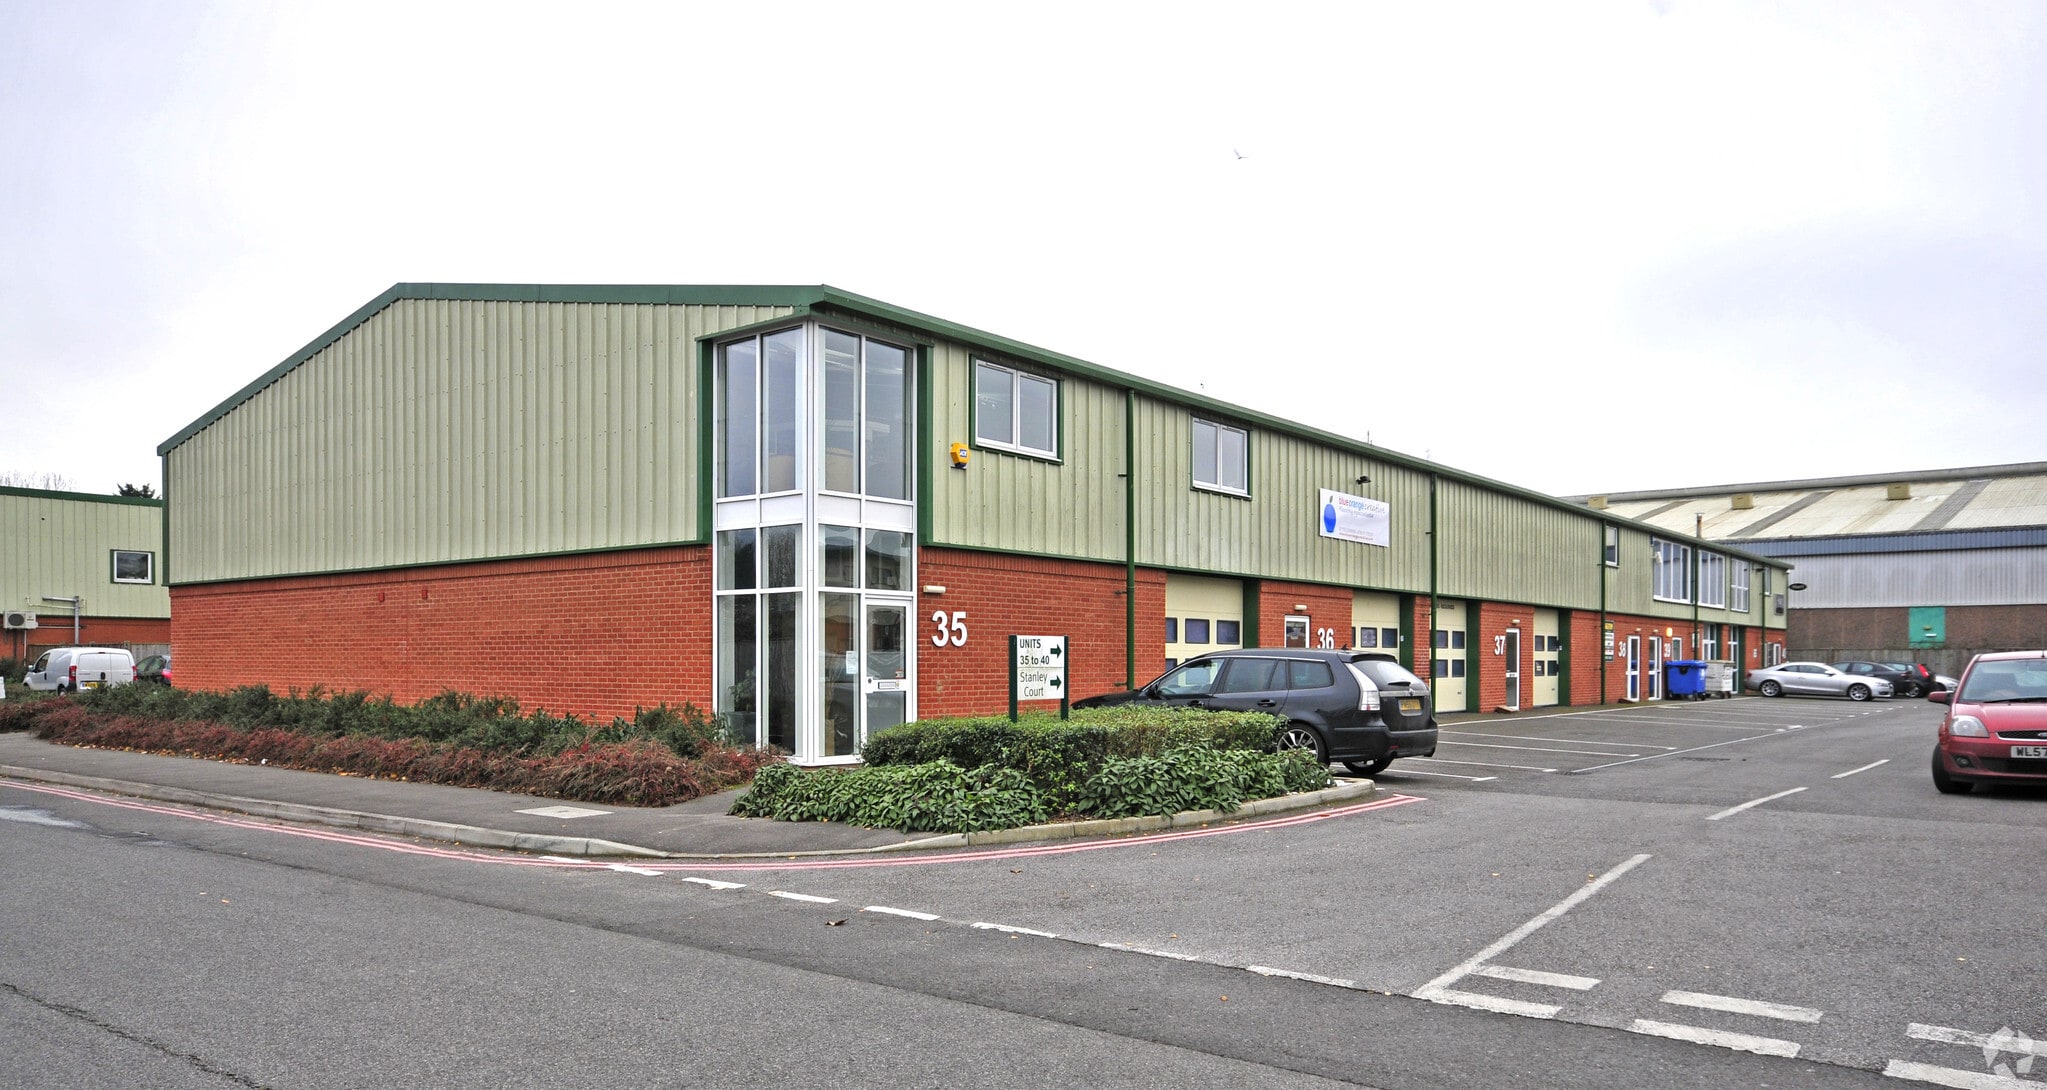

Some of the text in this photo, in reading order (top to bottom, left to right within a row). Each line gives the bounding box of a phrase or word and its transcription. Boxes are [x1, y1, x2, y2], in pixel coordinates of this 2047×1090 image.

[931, 610, 968, 647] 35
[1019, 638, 1042, 649] UNITS
[1317, 627, 1335, 649] 36
[1494, 635, 1506, 655] 37
[1020, 655, 1050, 665] 35 to 40
[1020, 671, 1048, 684] Stanley
[1023, 686, 1044, 697] Court
